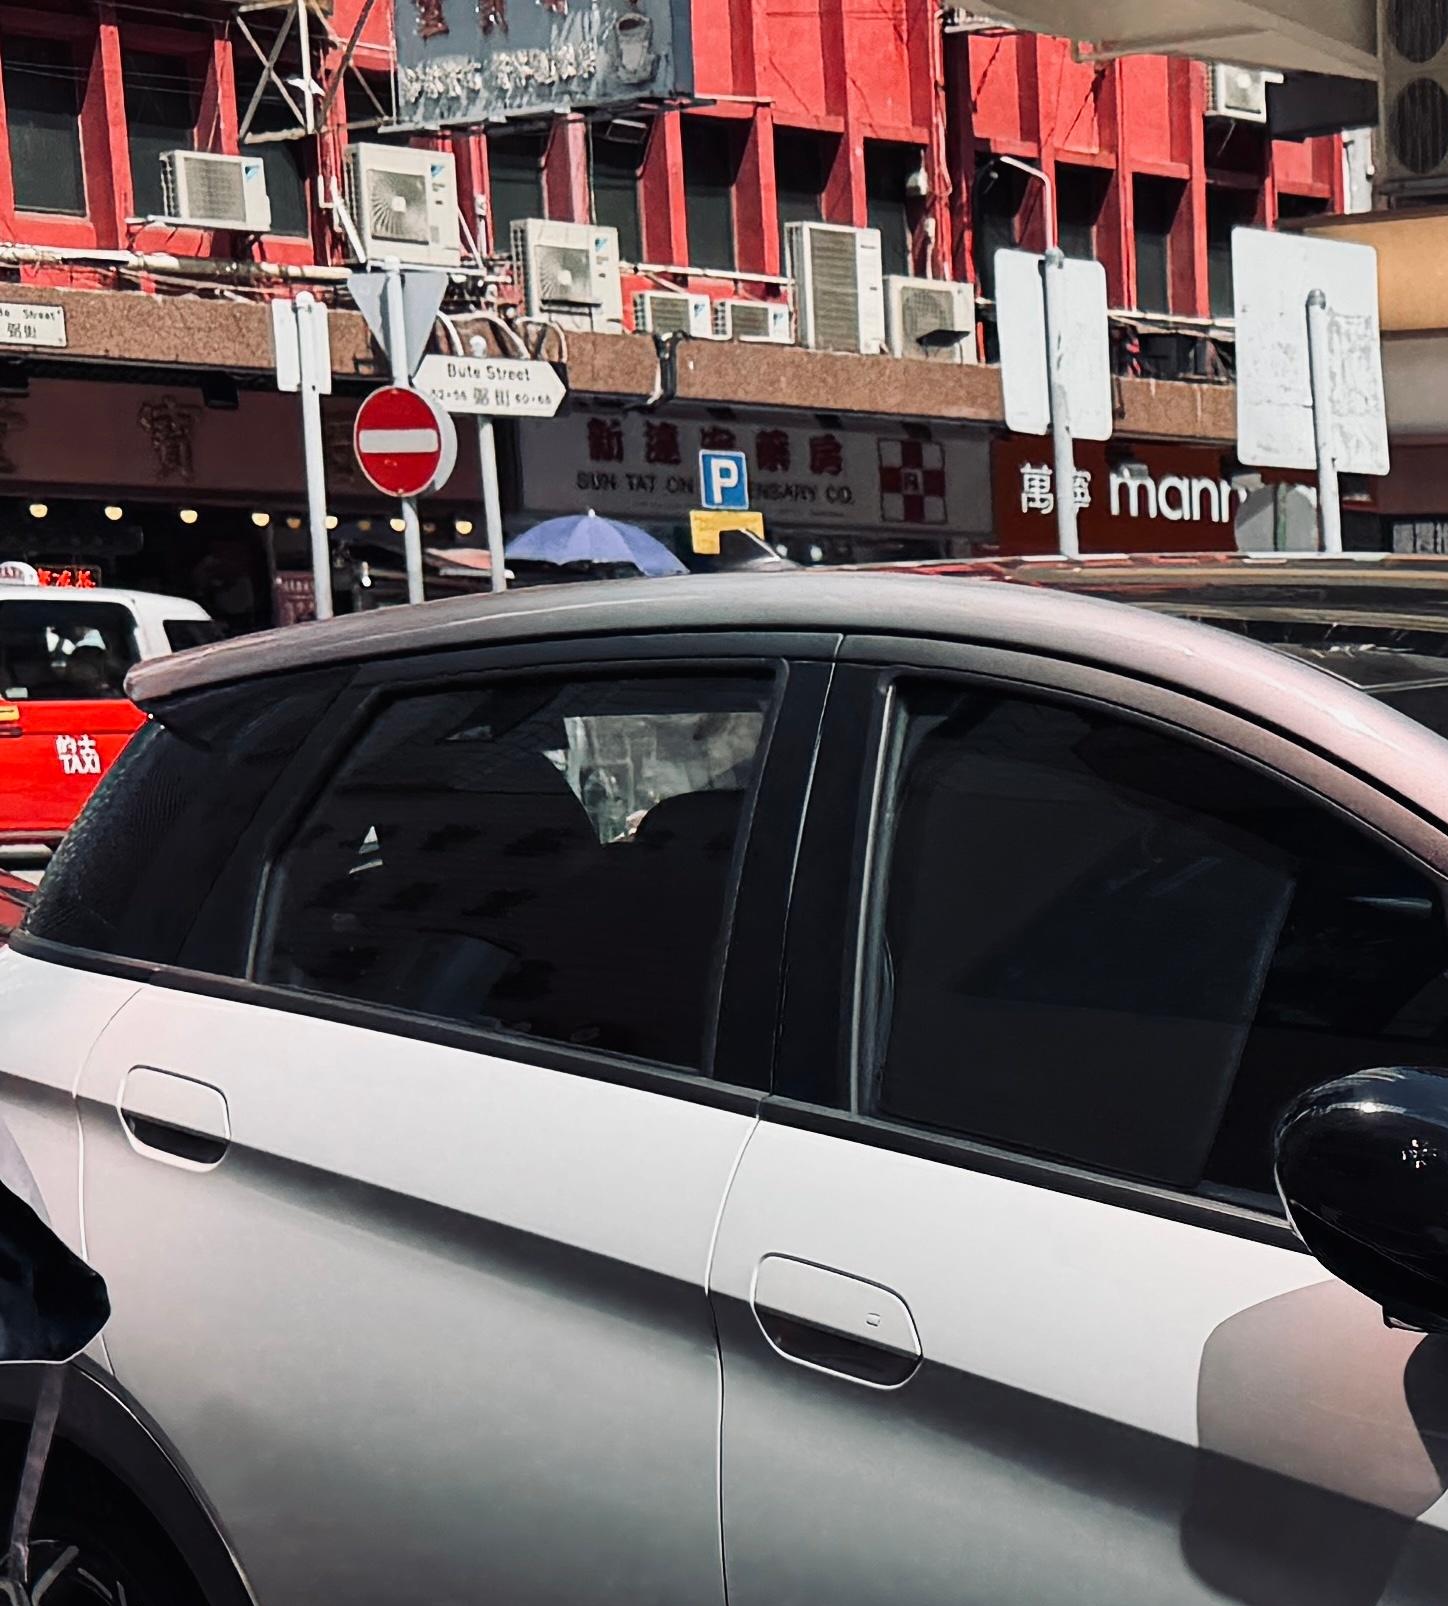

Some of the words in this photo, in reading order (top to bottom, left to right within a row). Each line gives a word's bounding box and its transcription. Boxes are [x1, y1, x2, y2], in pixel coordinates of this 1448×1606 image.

[447, 363, 481, 379] Bute
[486, 365, 531, 381] Street
[628, 474, 655, 492] TAT
[710, 458, 738, 504] P
[60, 752, 101, 775] TAXI
